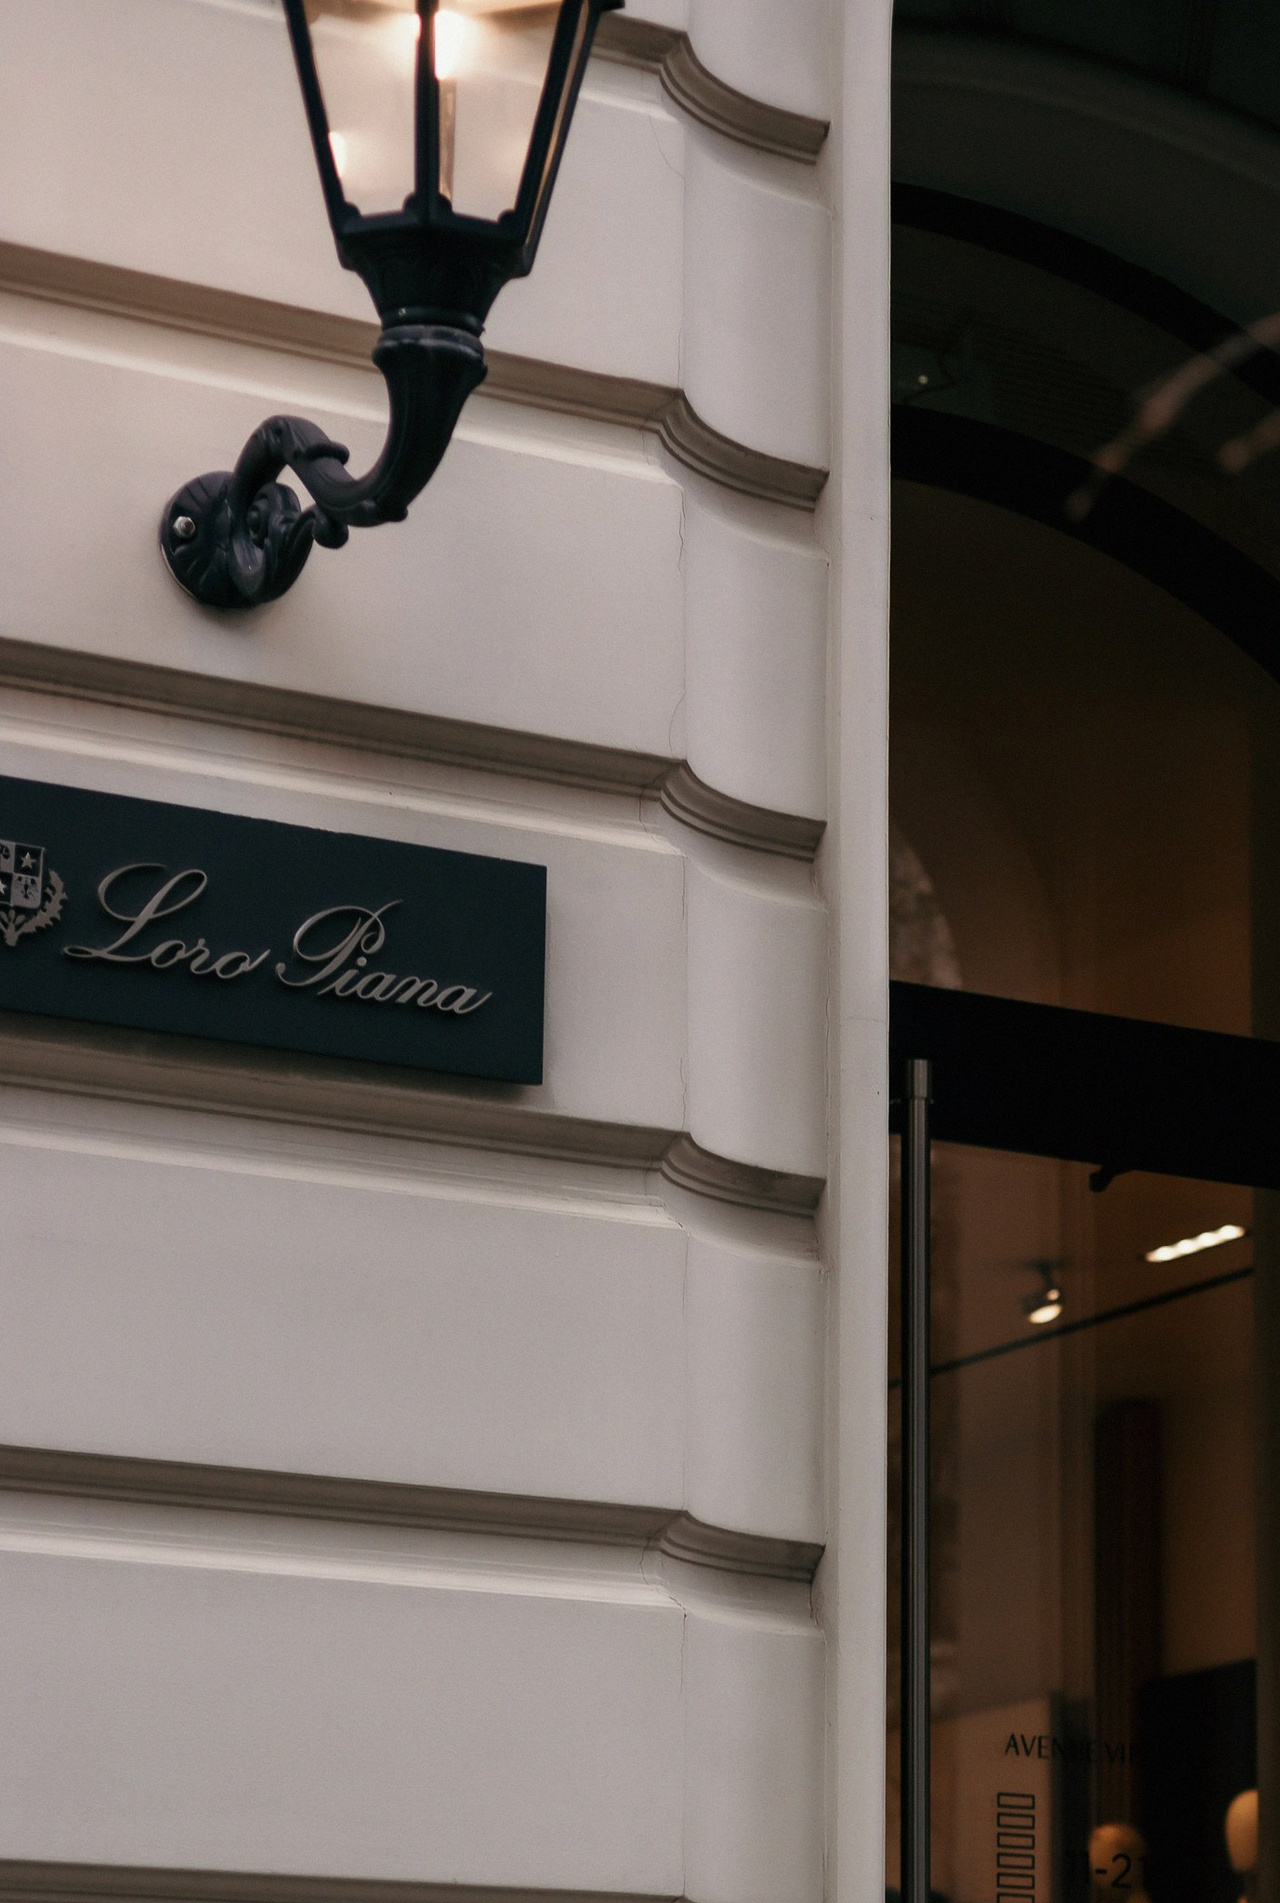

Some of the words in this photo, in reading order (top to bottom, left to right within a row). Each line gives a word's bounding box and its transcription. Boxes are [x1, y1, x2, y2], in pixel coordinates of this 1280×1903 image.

[62, 863, 271, 980] Loro
[274, 900, 492, 1015] Piana
[1004, 1732, 1099, 1762] AVENE
